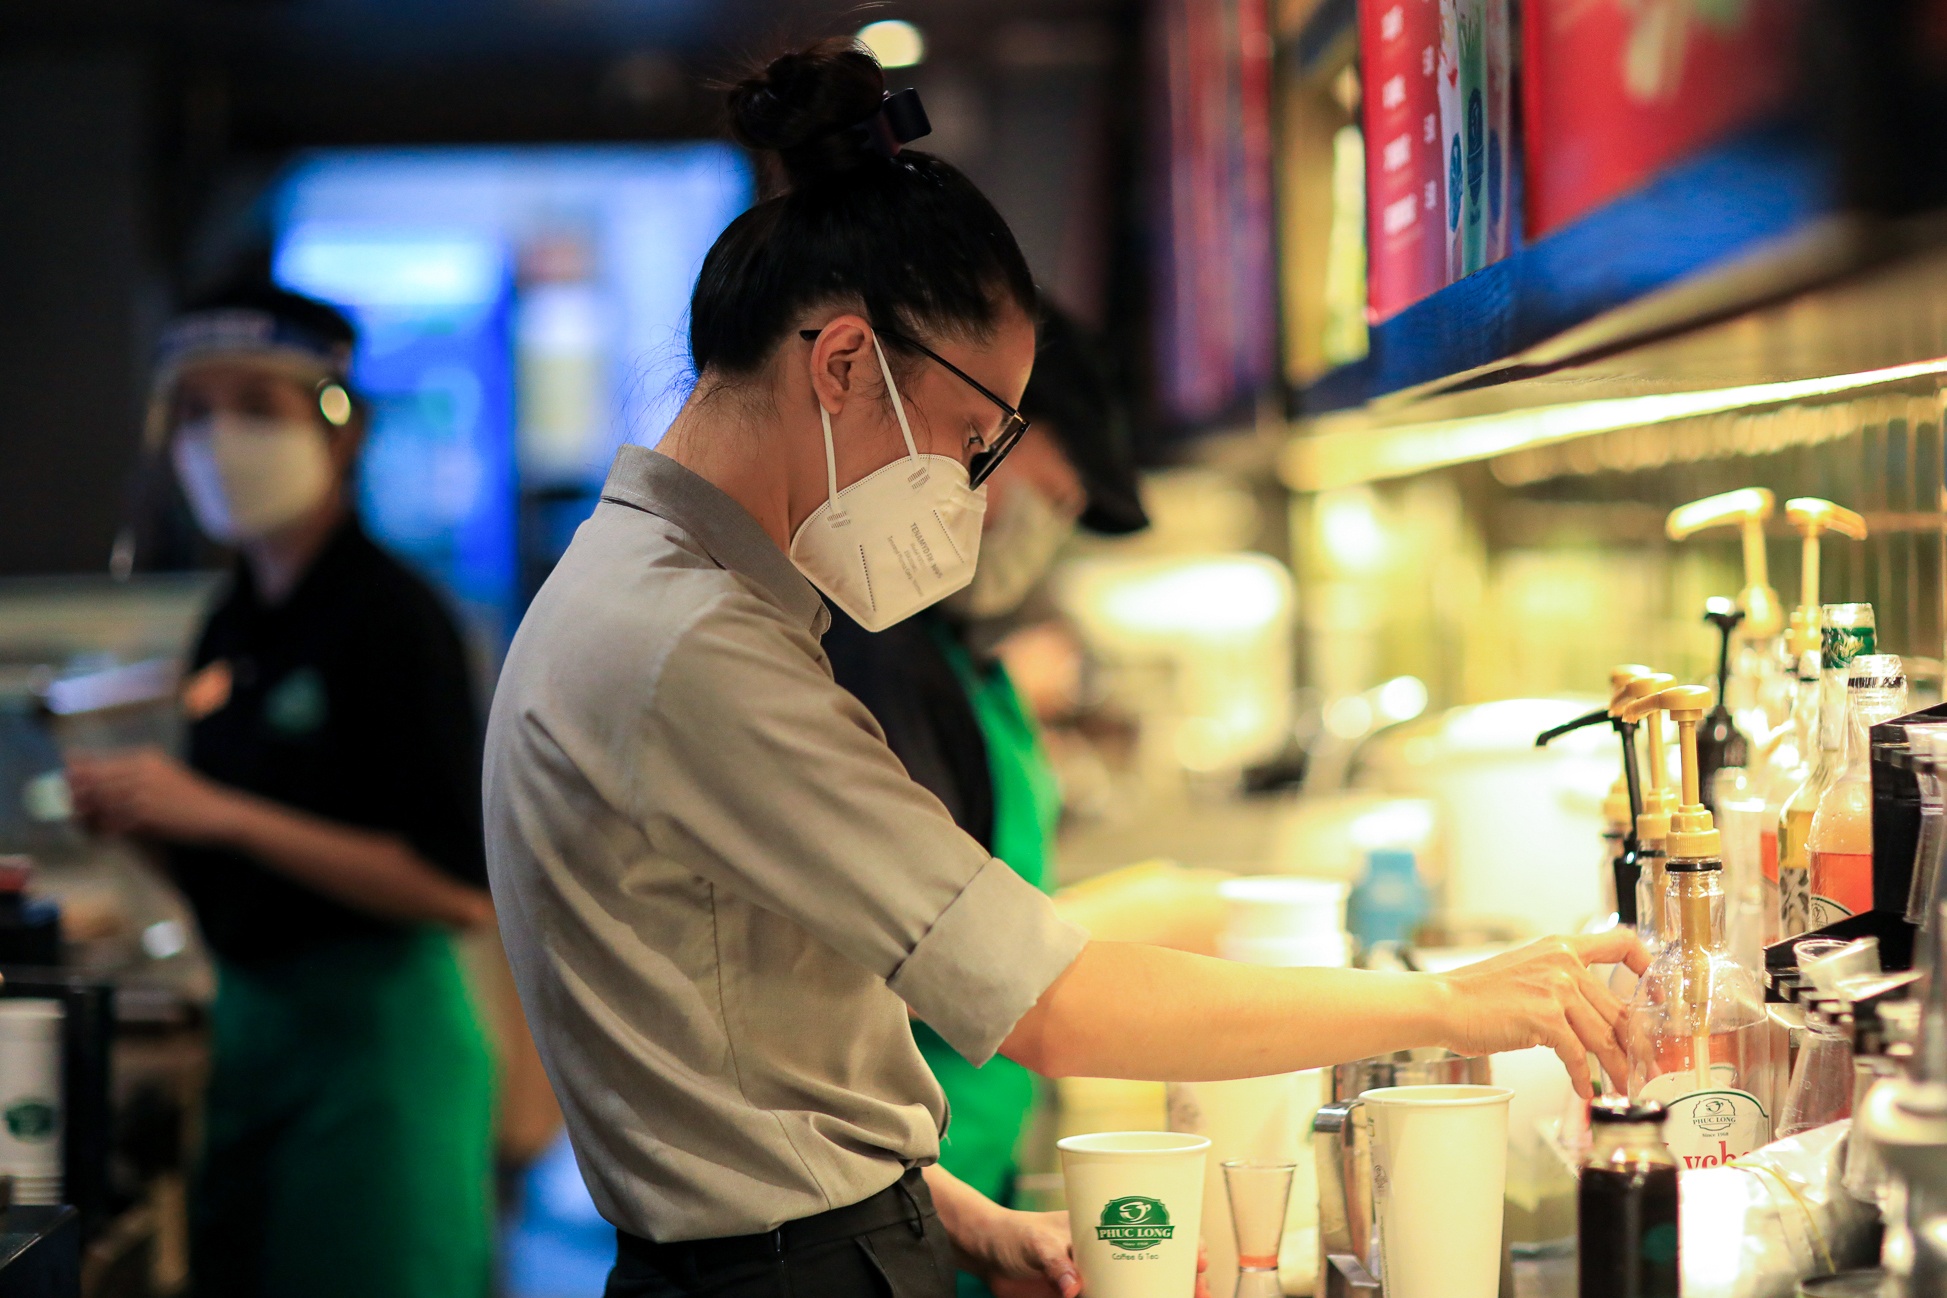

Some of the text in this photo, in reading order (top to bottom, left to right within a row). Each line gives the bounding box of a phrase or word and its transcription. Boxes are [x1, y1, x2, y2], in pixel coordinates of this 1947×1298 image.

[910, 522, 930, 554] TENAMYD
[1693, 1117, 1715, 1125] PHUC
[1099, 1228, 1171, 1238] PHUC LONG
[1112, 1252, 1136, 1261] Coffee
